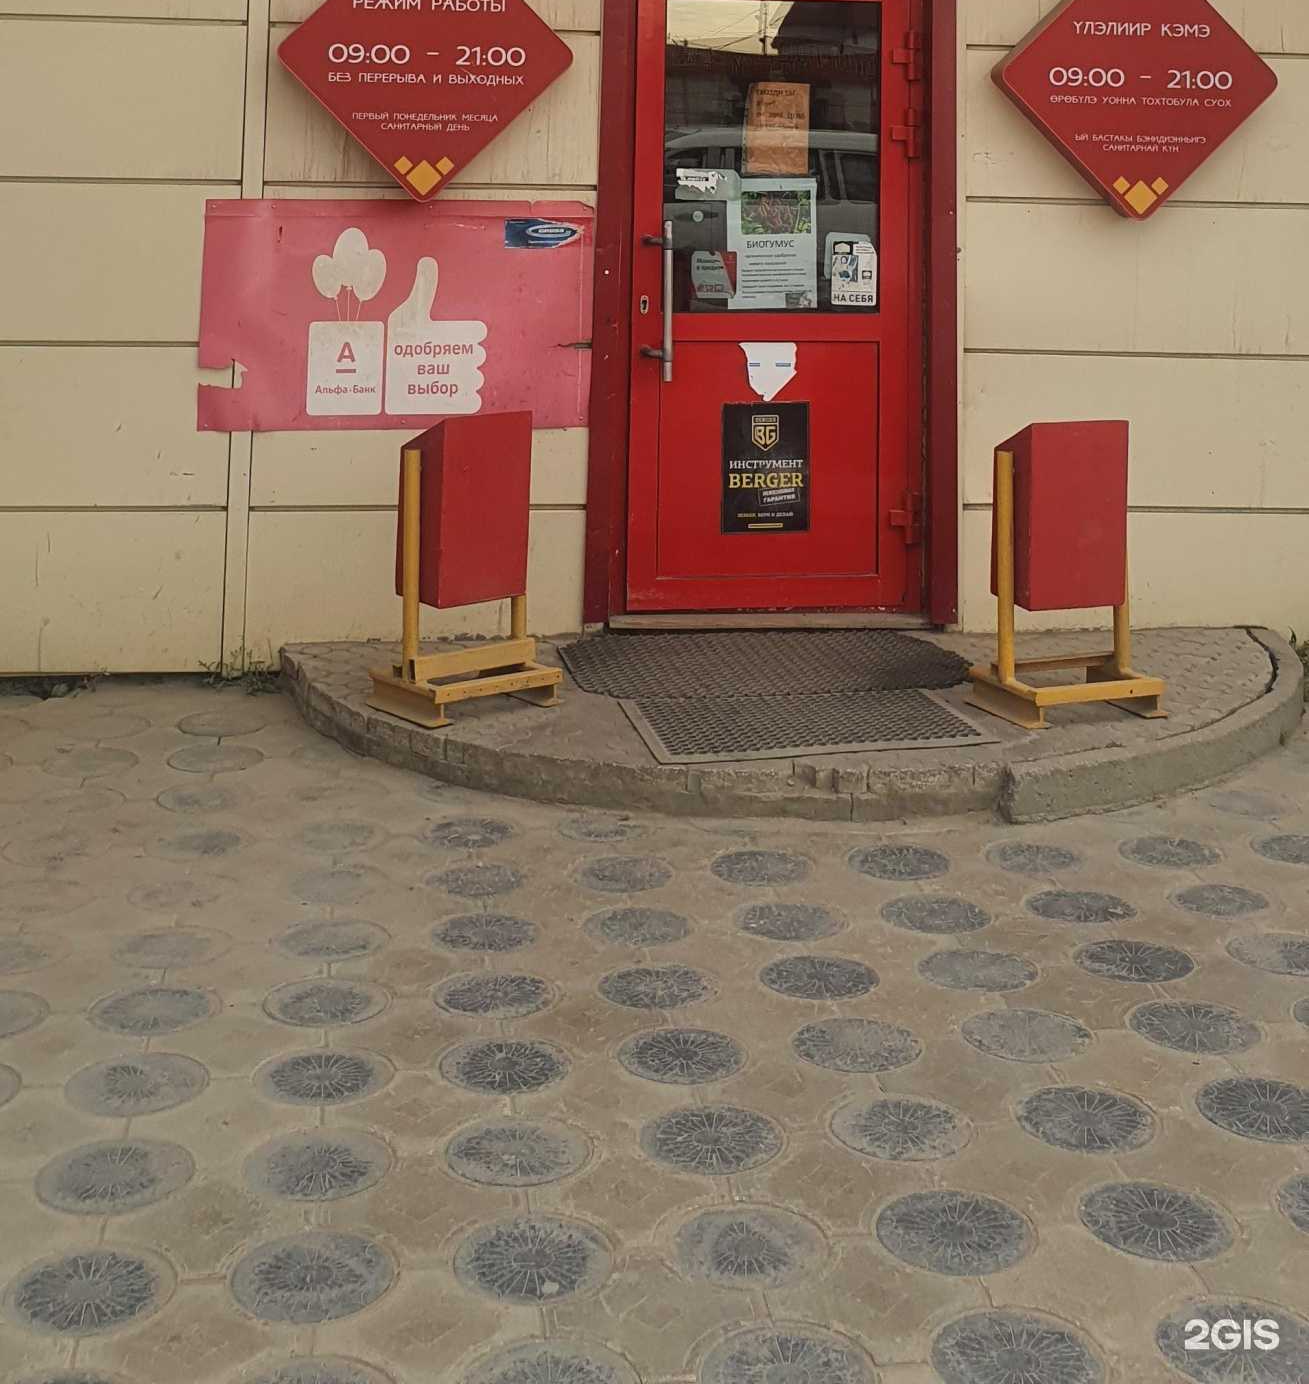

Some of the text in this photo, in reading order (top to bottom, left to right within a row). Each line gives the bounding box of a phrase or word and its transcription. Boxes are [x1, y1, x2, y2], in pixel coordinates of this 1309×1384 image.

[1073, 21, 1210, 38] ҮЛЭЛИИР КЭМЭ
[328, 43, 410, 64] 09:00
[455, 46, 526, 66] 21:00
[328, 72, 524, 86] БЕЗ ПЕРЕРЫВА И ВЫХОДНЫХ
[1049, 67, 1125, 88] 09:00
[1167, 69, 1233, 89] 21:00
[1102, 96, 1137, 106] УОННА
[1142, 97, 1200, 107] ТОХТОБУЛА
[1204, 98, 1232, 108] СУОХ
[352, 112, 498, 123] ПЕРВЫЙ ПОНЕДЕЛЬНИК МЕСЯЦА
[381, 122, 470, 132] САНИТАРНЫЙ ДЕНЬ
[1092, 134, 1133, 143] БАСТАКЫ
[746, 240, 795, 249] БИОГУМУС
[833, 294, 874, 304] НА СЕБЯ
[394, 341, 474, 358] одобряем
[417, 363, 450, 376] ваш
[314, 384, 377, 396] Альфа-Банк
[407, 380, 459, 397] выбор
[754, 426, 776, 446] BG
[729, 459, 804, 470] ИНСТРУМЕНТ
[728, 472, 804, 489] BERGER
